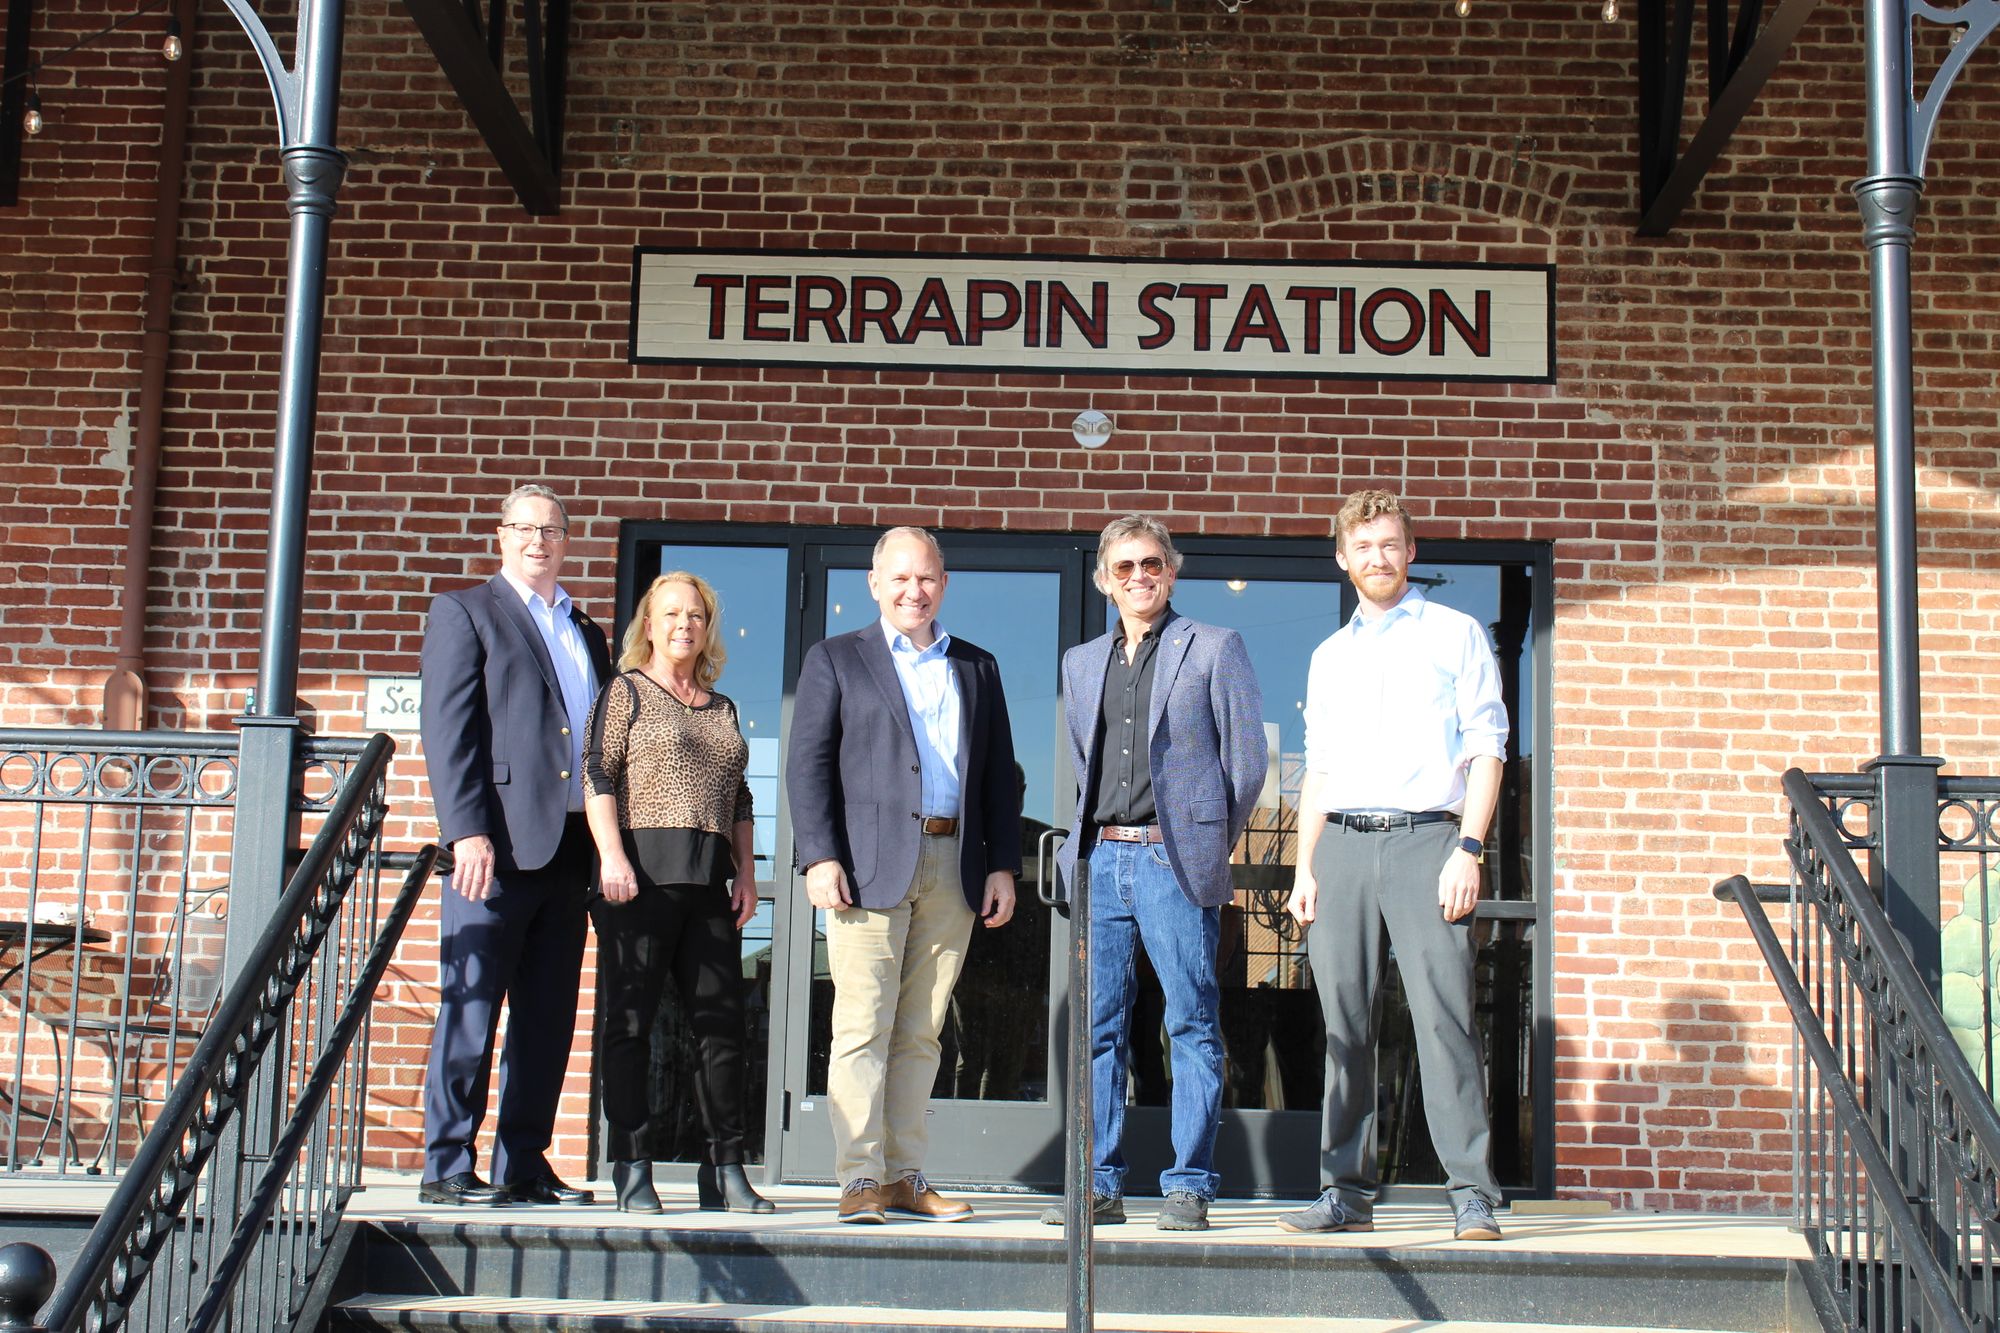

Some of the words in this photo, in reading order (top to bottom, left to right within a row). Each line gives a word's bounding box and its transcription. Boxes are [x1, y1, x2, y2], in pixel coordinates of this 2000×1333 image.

[694, 274, 1108, 348] TERRAPIN
[1137, 282, 1491, 357] STATION
[380, 686, 421, 715] Sa
